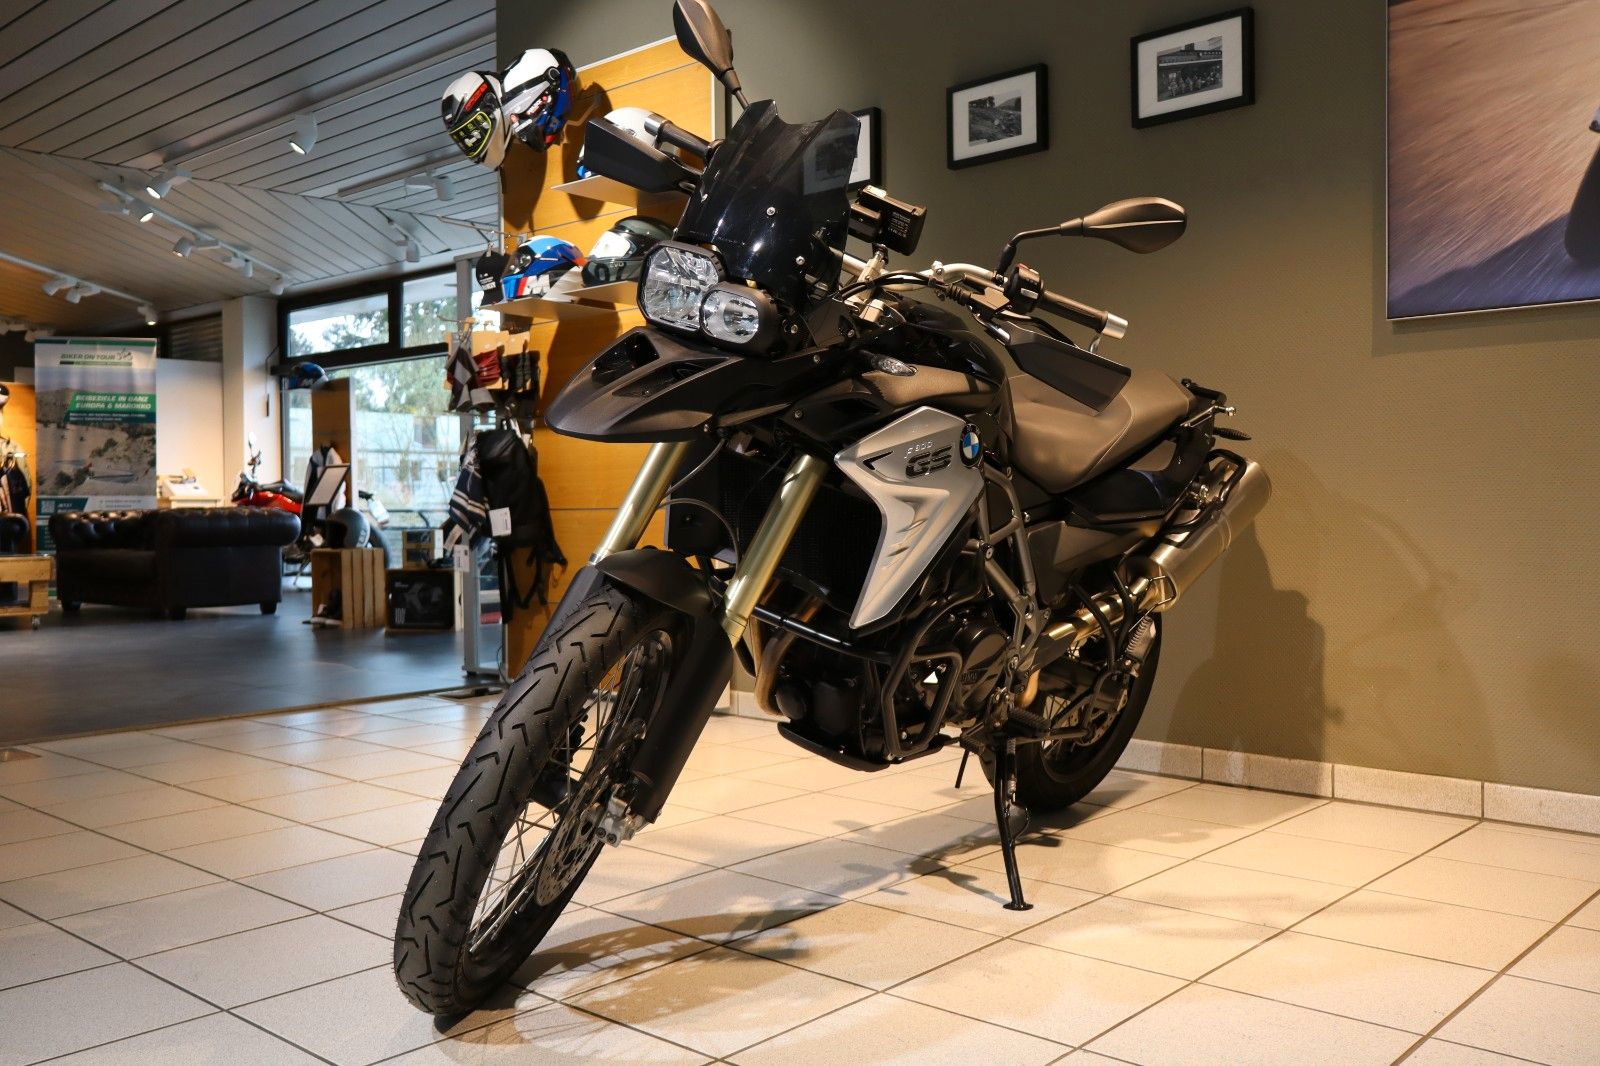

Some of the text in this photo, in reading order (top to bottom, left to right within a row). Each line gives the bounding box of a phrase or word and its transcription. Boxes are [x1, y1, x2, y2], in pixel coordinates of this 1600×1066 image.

[118, 394, 127, 402] IN
[114, 402, 152, 410] MAROKKO
[905, 444, 953, 478] GS
